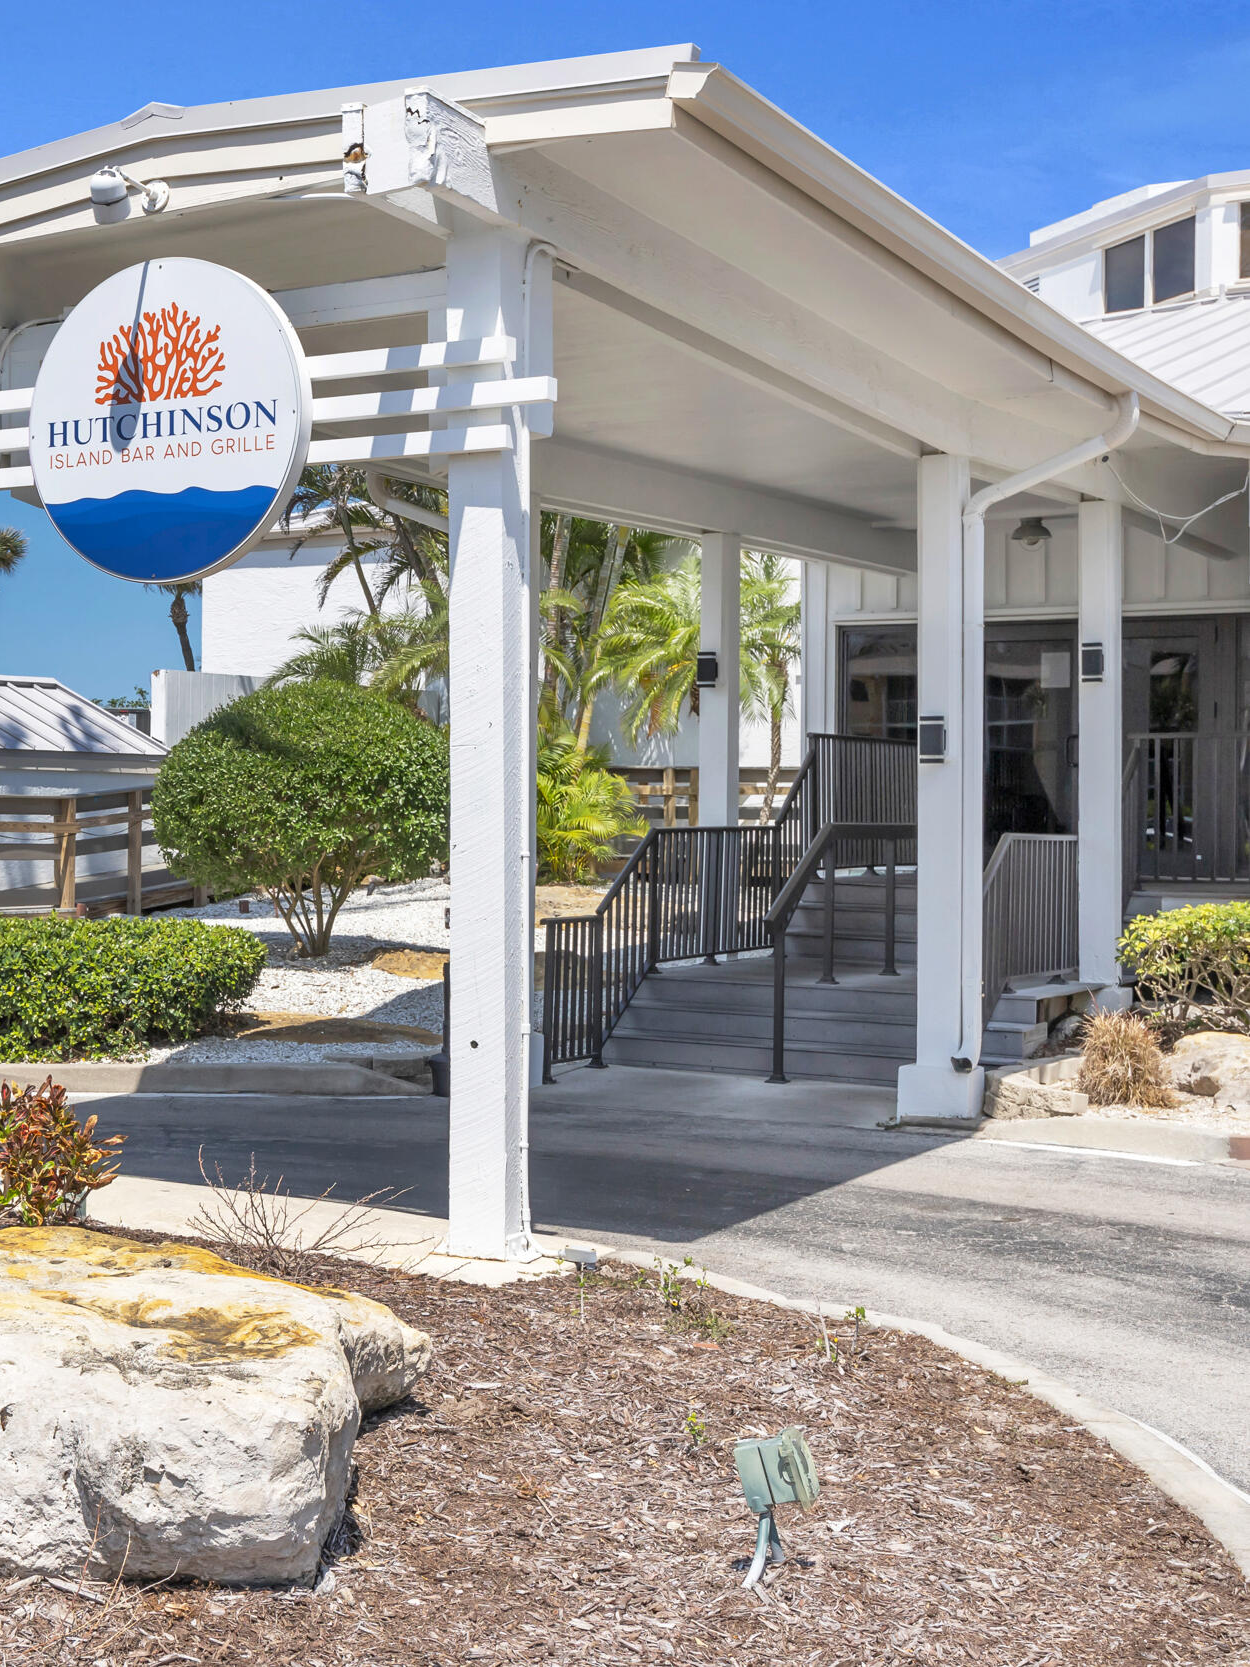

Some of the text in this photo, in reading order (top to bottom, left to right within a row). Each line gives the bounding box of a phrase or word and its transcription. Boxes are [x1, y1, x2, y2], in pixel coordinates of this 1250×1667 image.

[47, 399, 278, 448] HUTCHINSON
[50, 434, 276, 469] ISLAND BAR AND GRILLE
